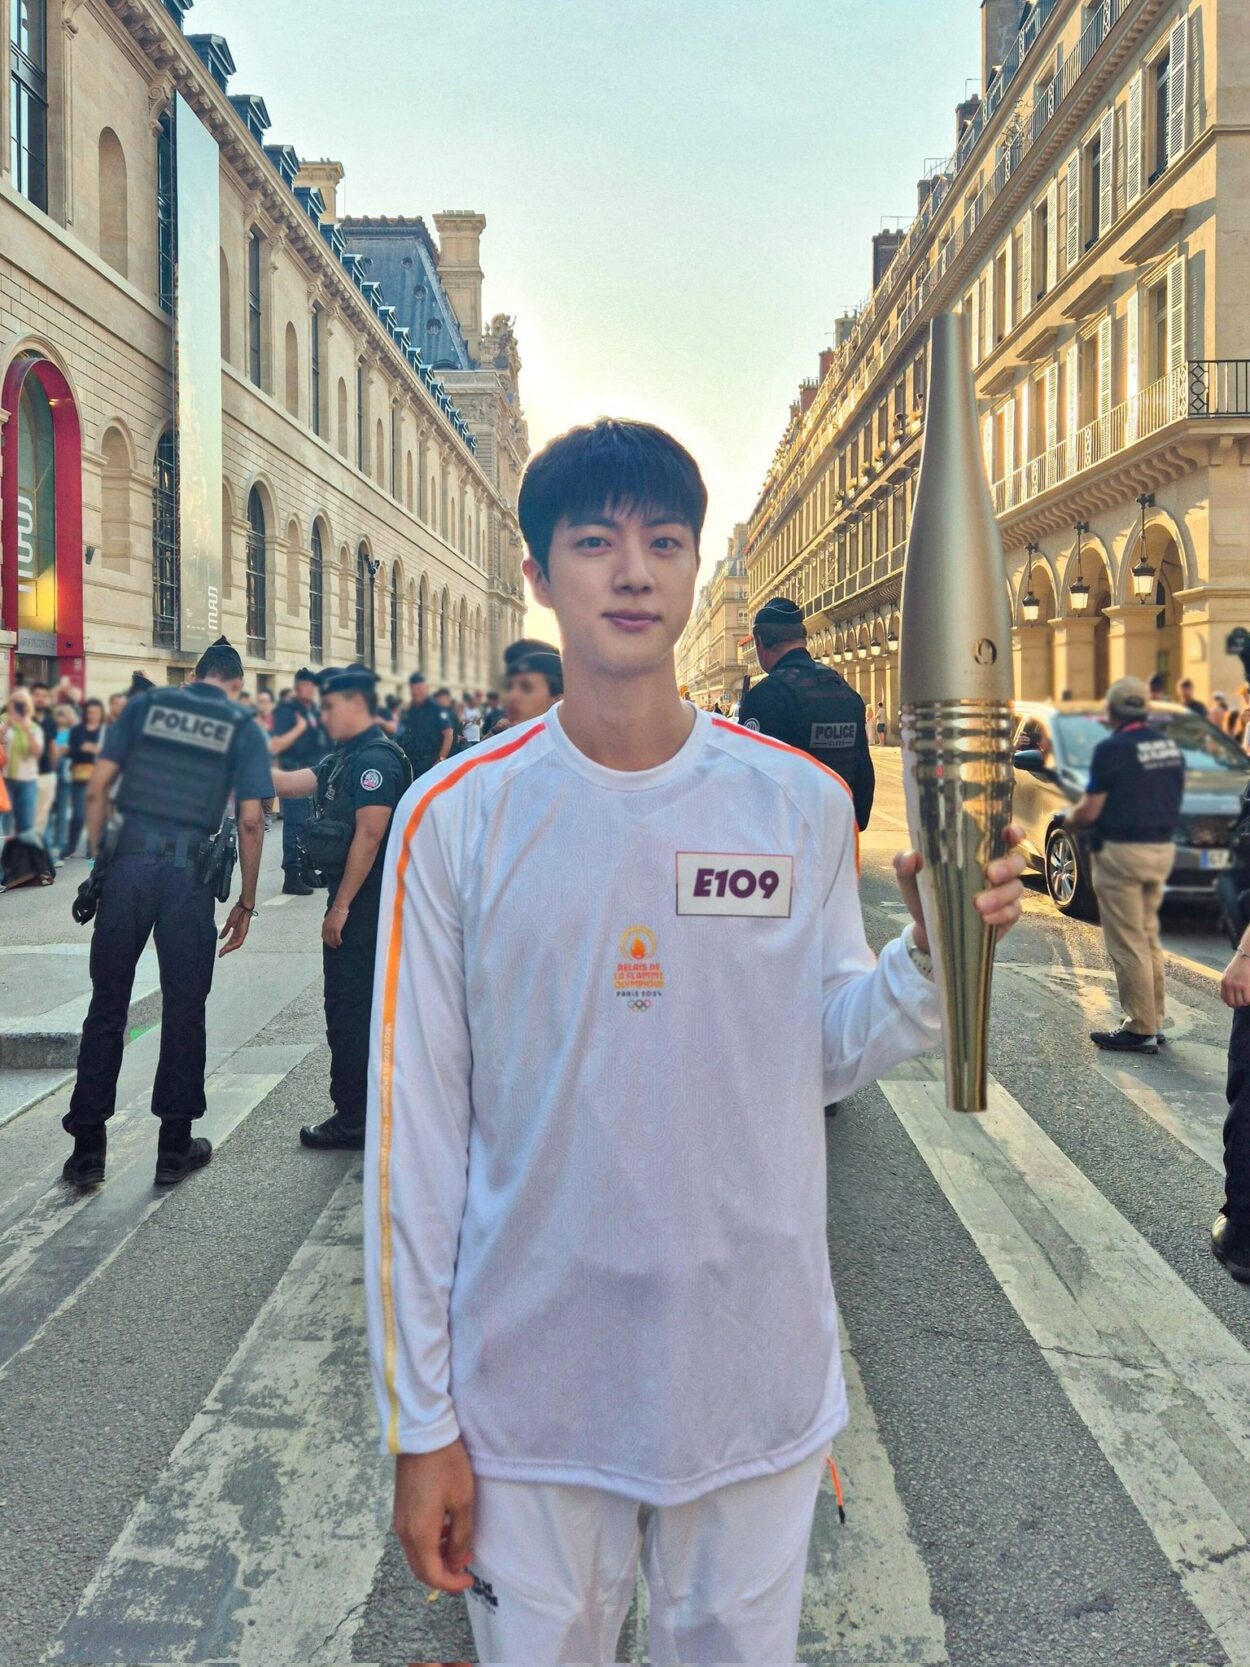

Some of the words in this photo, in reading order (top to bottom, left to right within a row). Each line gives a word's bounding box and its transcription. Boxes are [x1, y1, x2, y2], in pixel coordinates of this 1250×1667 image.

[150, 709, 229, 742] POLICE
[815, 725, 855, 739] POLICE
[693, 868, 779, 899] E109
